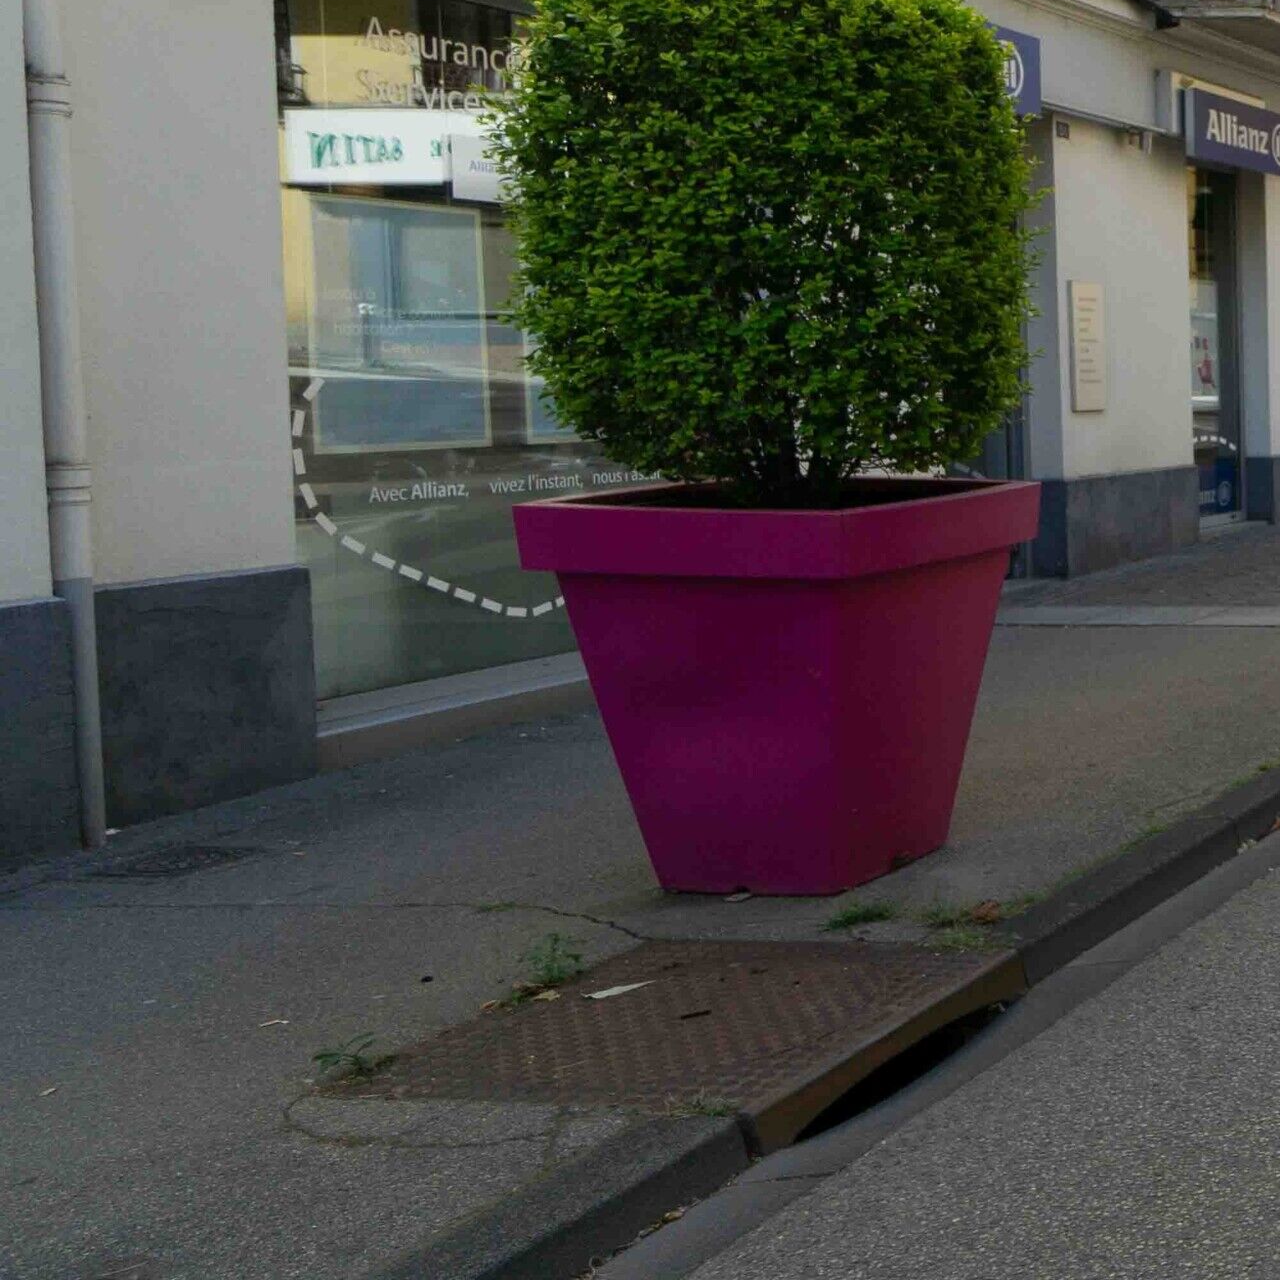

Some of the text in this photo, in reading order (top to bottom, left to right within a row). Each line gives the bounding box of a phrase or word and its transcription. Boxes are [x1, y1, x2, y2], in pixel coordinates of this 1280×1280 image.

[1206, 108, 1270, 155] Allianz
[369, 485, 408, 503] Avec
[410, 481, 470, 501] Allianz,
[489, 476, 525, 494] vivez
[528, 473, 584, 493] l'instant,
[593, 470, 622, 485] nous
